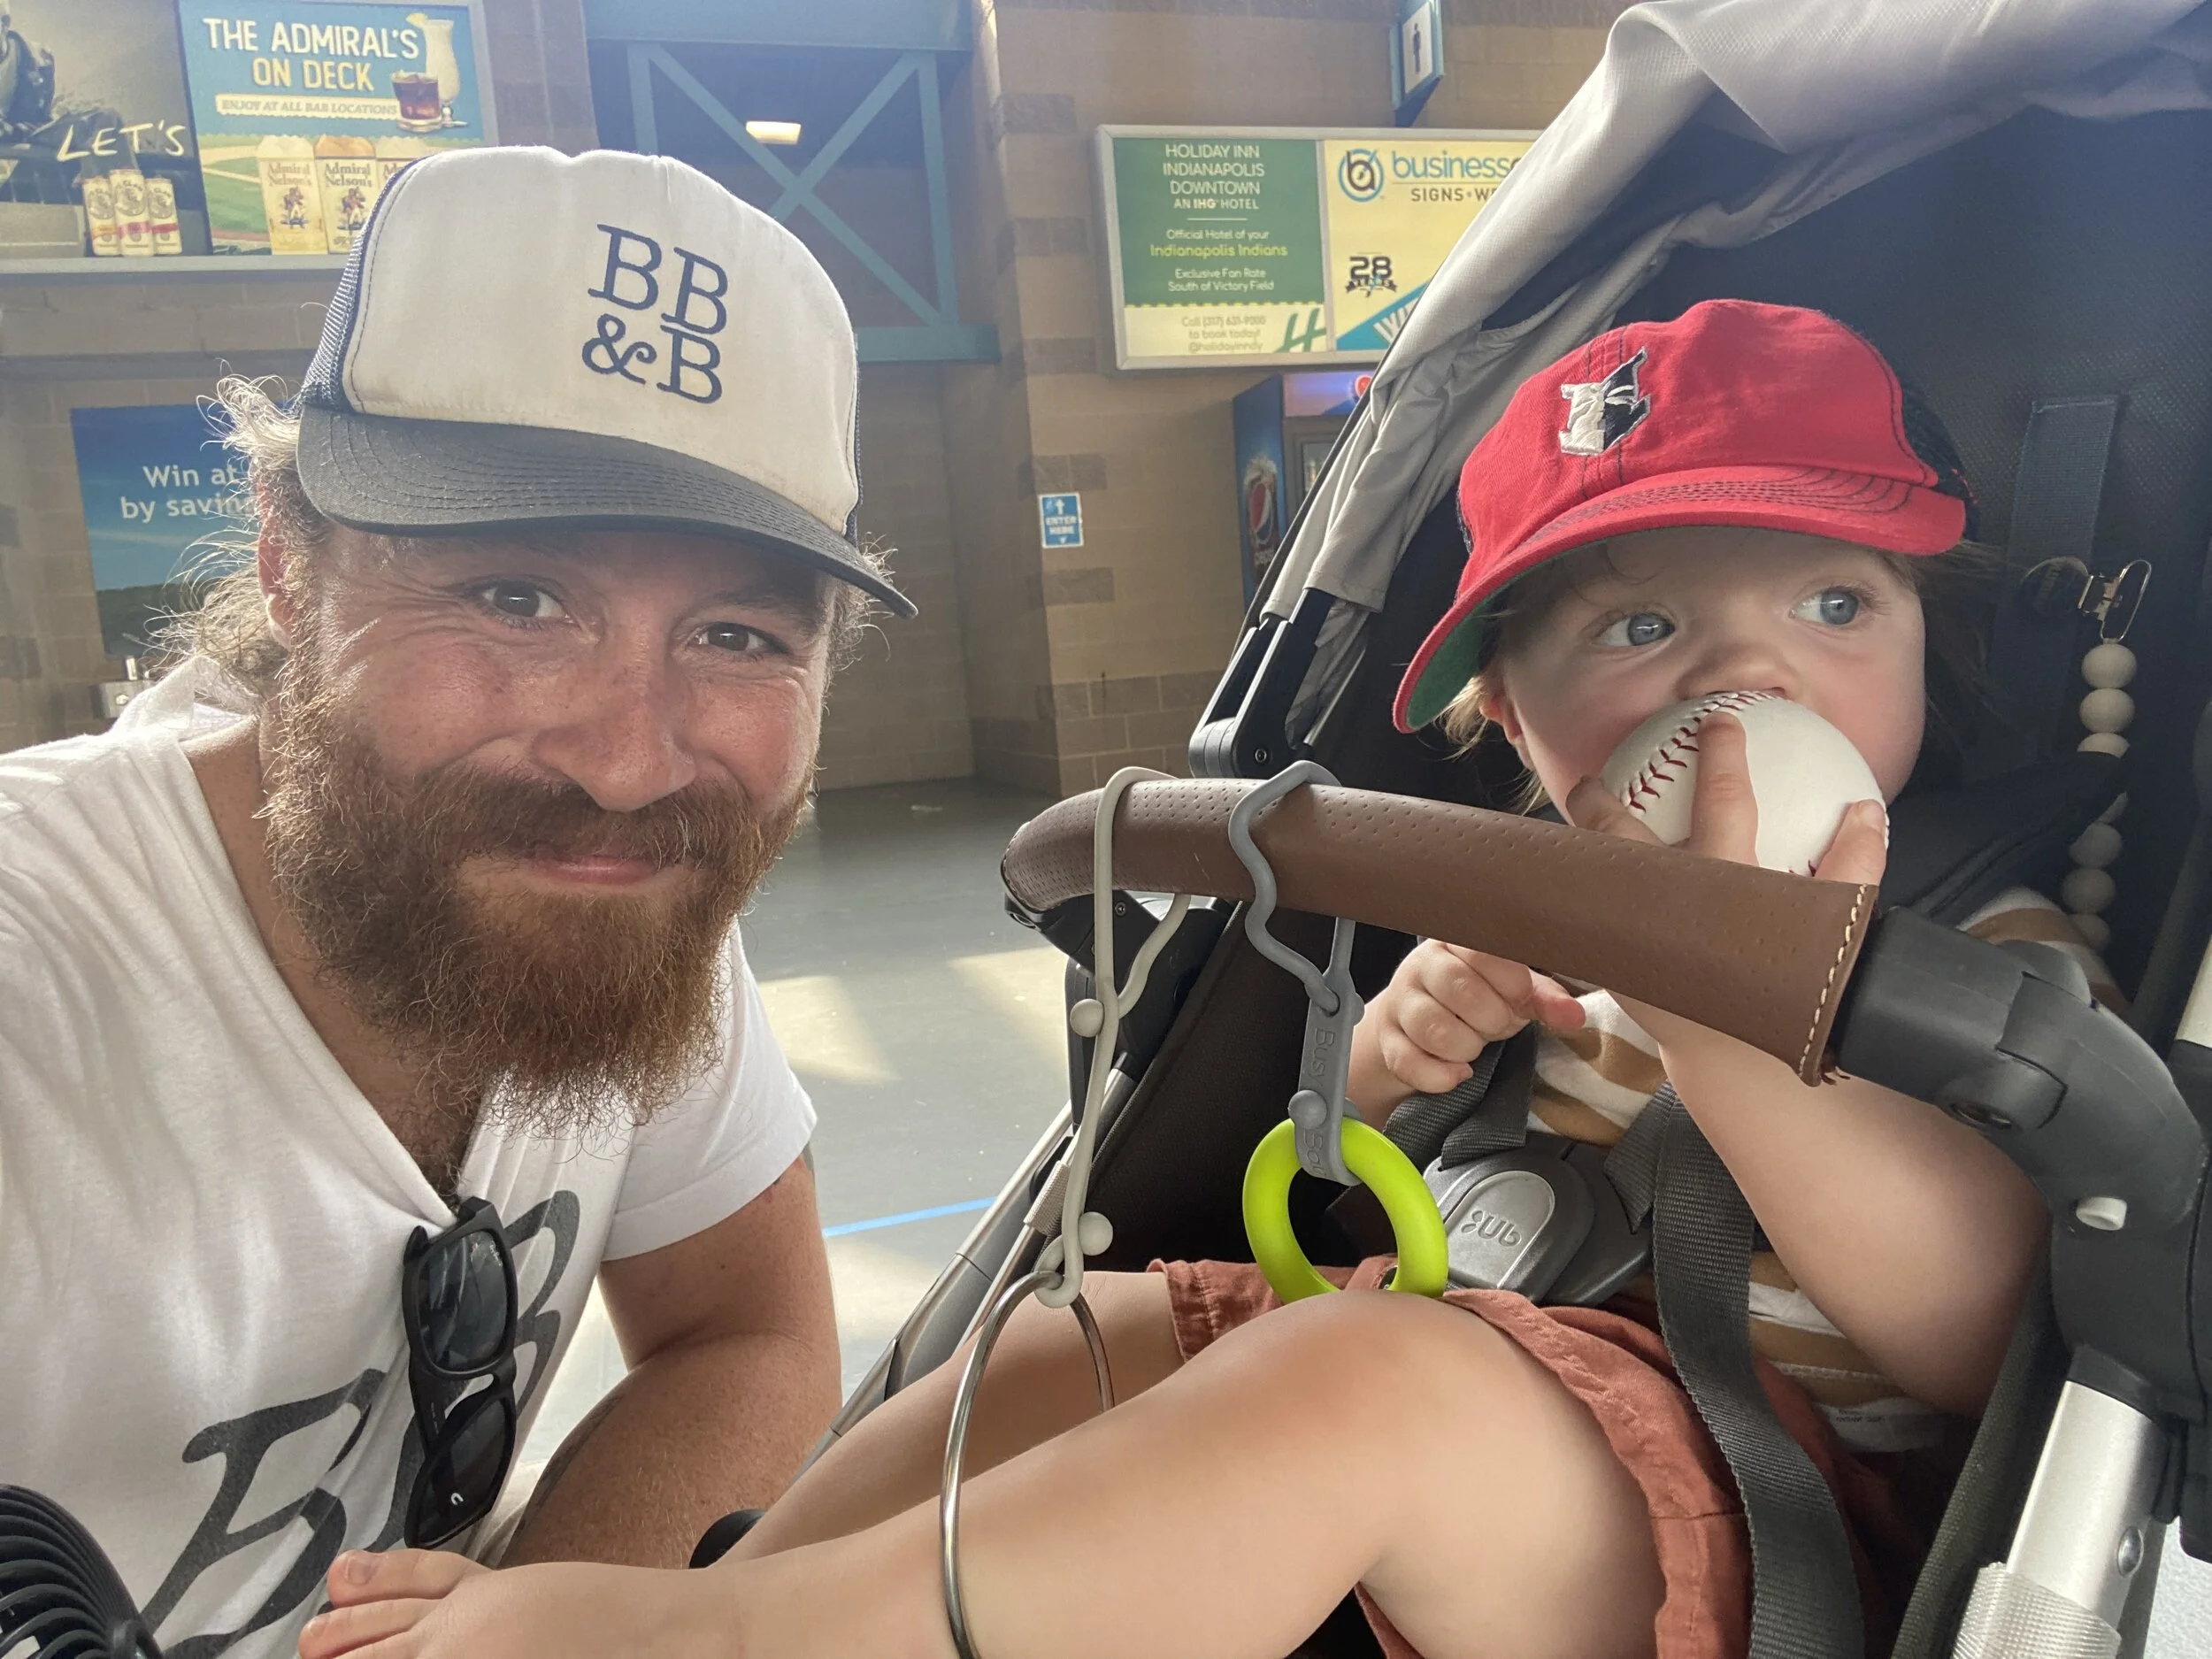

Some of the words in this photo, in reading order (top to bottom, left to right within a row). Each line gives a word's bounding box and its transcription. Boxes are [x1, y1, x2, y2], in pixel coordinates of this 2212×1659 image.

[202, 18, 258, 51] THE
[271, 22, 419, 58] ADMIRAL'S
[253, 58, 291, 88] ON
[303, 59, 374, 92] DECK
[222, 99, 260, 111] ENJOY
[263, 101, 278, 111] AT
[280, 102, 302, 112] ALL
[305, 103, 328, 113] BAR
[331, 103, 397, 114] LOCATIONS
[57, 119, 186, 162] LET'S
[1165, 143, 1230, 158] HOLIDAY
[1233, 144, 1260, 158] INN
[325, 162, 371, 174] Admiral
[1163, 162, 1265, 177] INDIANAPOLIS
[326, 174, 373, 187] Nelson's
[1170, 180, 1261, 195] DOWNTOWN
[1411, 188, 1465, 203] SIGNS
[1173, 198, 1191, 209] AN
[1220, 198, 1260, 210] HOTEL
[1166, 229, 1203, 240] Official
[1205, 229, 1233, 240] Hotel
[1234, 229, 1246, 240] of
[1246, 231, 1270, 242] your
[1150, 243, 1235, 259] Indianapolis
[1239, 243, 1288, 257] Indians
[1175, 268, 1220, 279] Exclusive
[1221, 268, 1242, 279] Fan
[1243, 267, 1266, 278] Rate
[1349, 256, 1393, 280] 28
[1168, 280, 1199, 292] South
[1200, 280, 1211, 292] of
[1213, 280, 1248, 293] Victory
[1249, 280, 1275, 291] Field
[142, 465, 199, 488] Win
[120, 495, 156, 524] by
[1304, 1028, 1335, 1087] Busy
